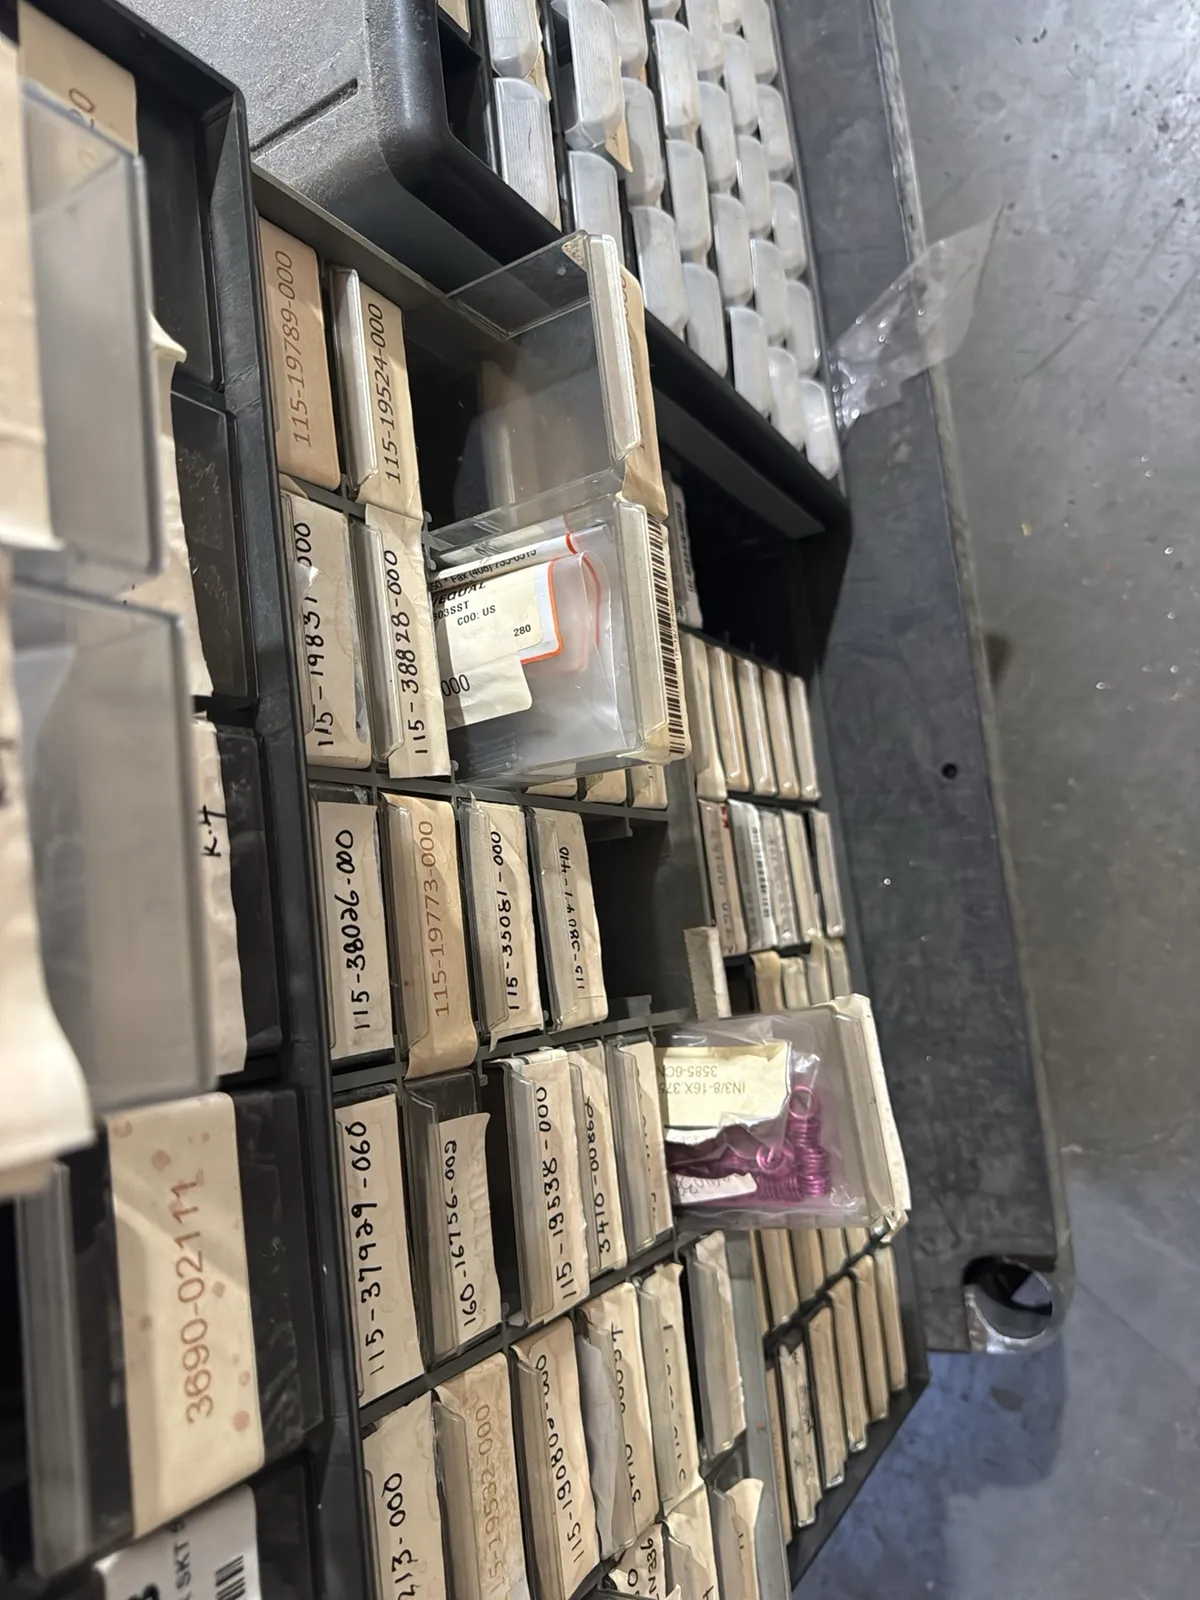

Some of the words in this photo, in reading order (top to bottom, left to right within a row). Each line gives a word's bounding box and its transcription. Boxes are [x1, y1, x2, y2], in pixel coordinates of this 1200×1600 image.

[274, 250, 312, 447] 115-19789-000
[368, 303, 401, 483] 115-19524-000
[384, 550, 428, 755] 115-38828-000
[483, 605, 496, 616] US
[514, 625, 531, 637] 280
[334, 829, 370, 1030] 115-38026-000
[418, 821, 450, 1017] 115-19773-000
[170, 1180, 213, 1425] 3690-02111
[344, 1121, 386, 1376] 115-37929-060
[444, 1140, 476, 1327] 160-16756-002
[174, 1540, 192, 1586] SKT
